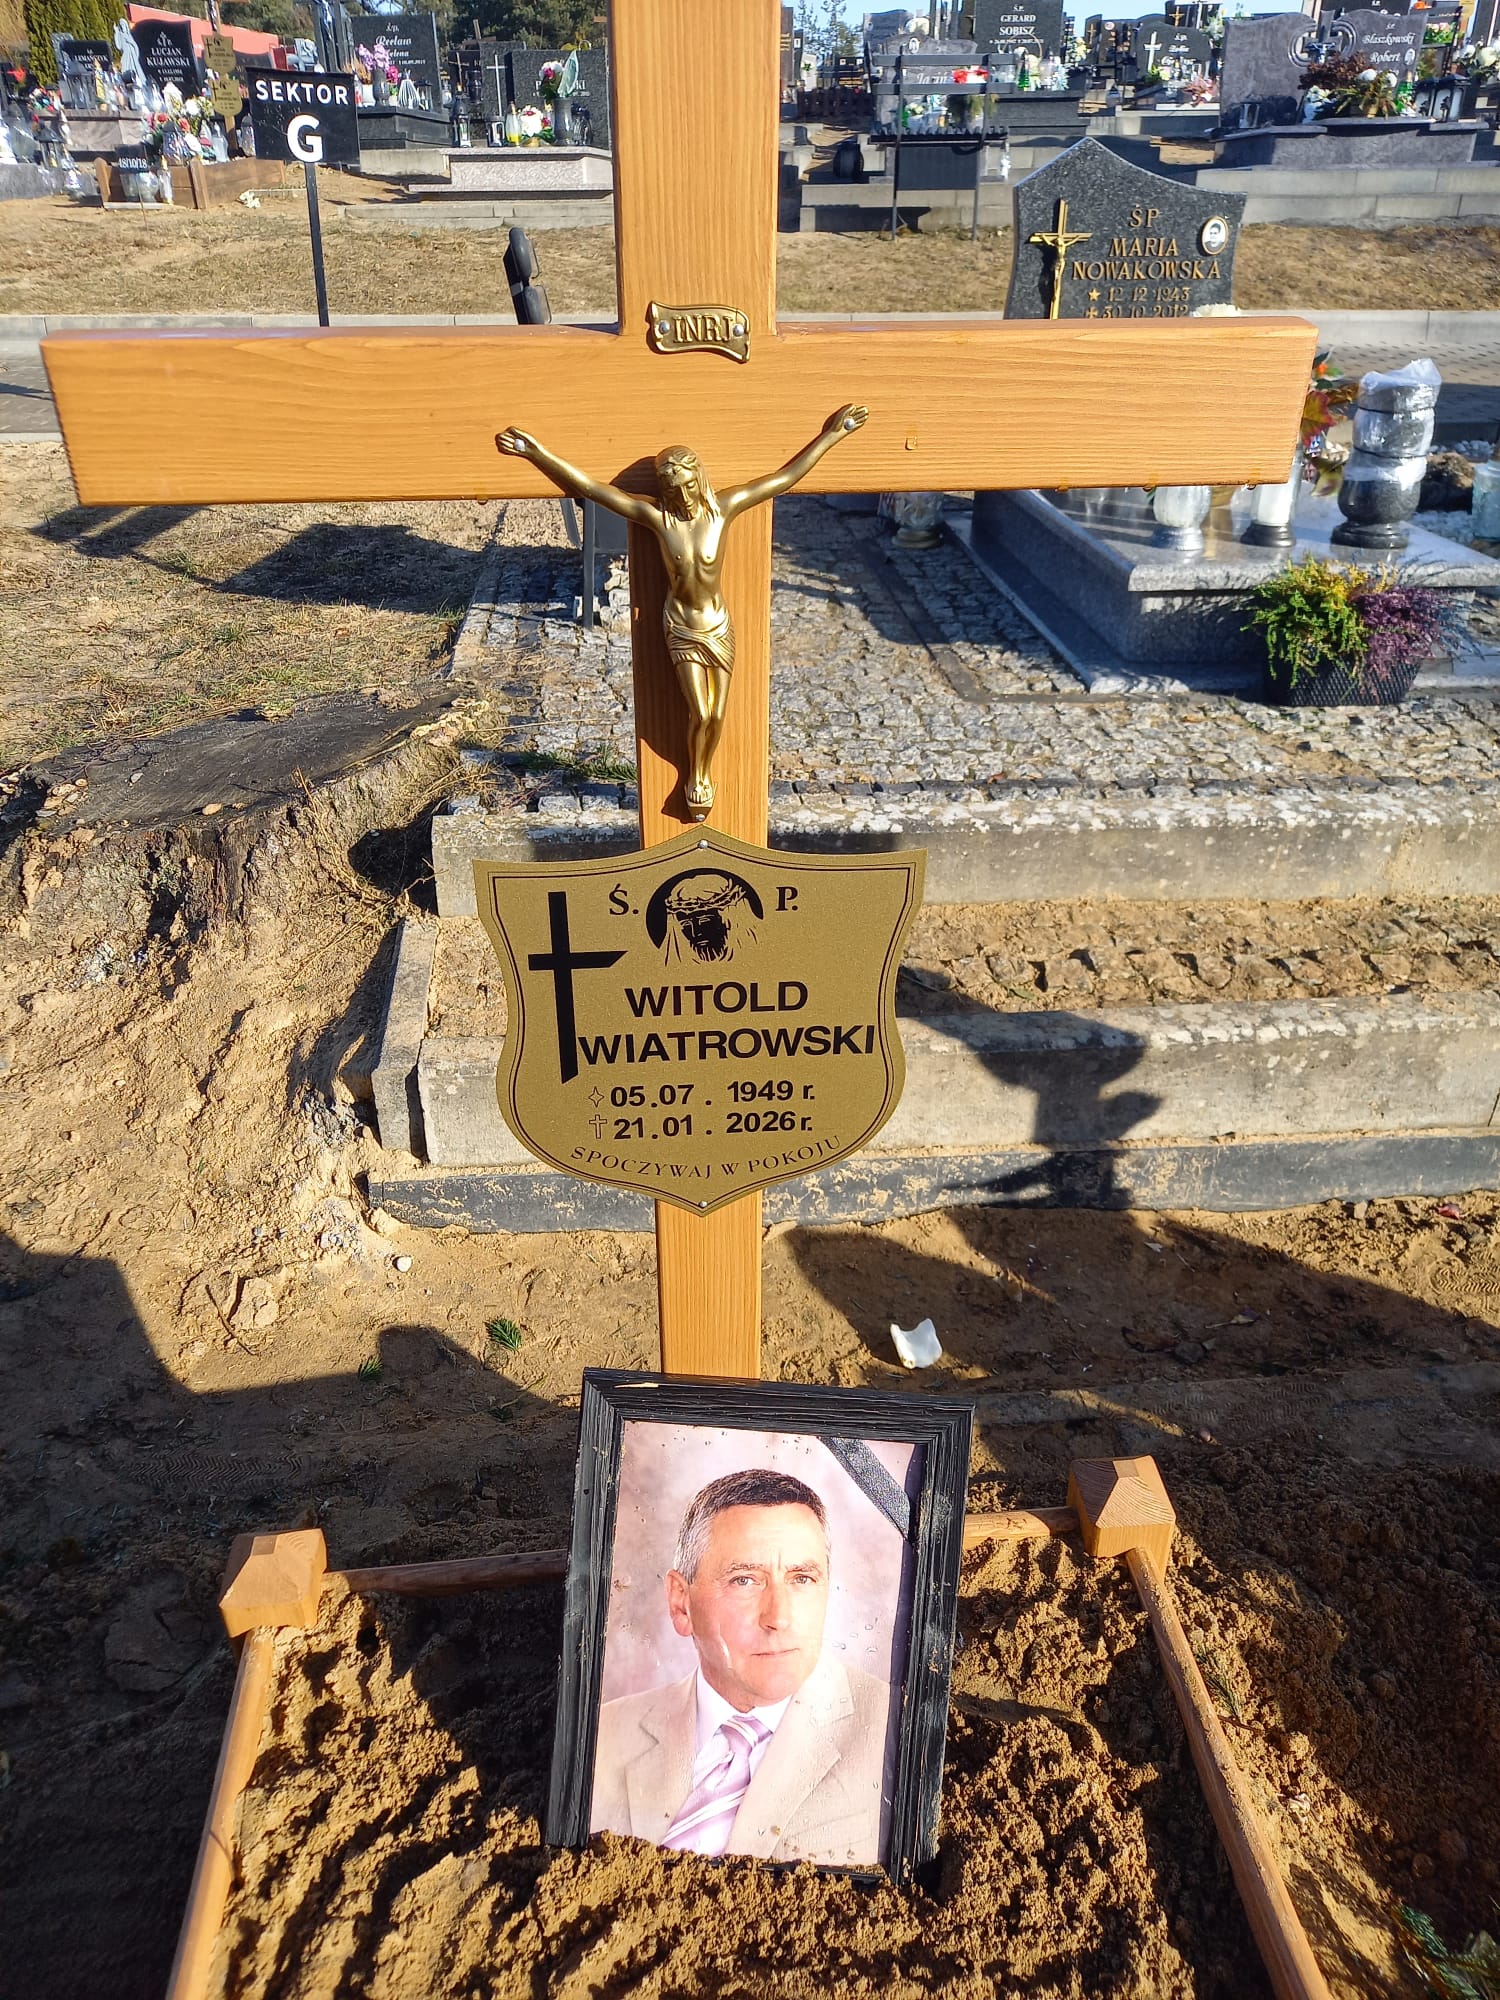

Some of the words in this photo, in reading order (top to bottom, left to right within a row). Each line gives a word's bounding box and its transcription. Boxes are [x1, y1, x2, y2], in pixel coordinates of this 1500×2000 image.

[1000, 14, 1036, 23] GERARD
[1000, 26, 1036, 36] SOBISZ
[146, 57, 190, 67] KUJAWSKI
[1370, 50, 1401, 64] Robert
[255, 79, 349, 106] SEKTOR
[286, 114, 324, 163] G
[1128, 203, 1161, 229] ŚP
[1108, 237, 1180, 257] MARIA
[1072, 259, 1221, 281] NOWAKOWSKA
[672, 313, 734, 343] INRI
[608, 883, 640, 916] Ś.
[775, 886, 799, 912] P.
[624, 981, 809, 1018] WITOLD
[578, 1024, 876, 1066] WIATROWSKI
[726, 1080, 794, 1103] 1949
[570, 1146, 712, 1180] SPOCZYWAJ
[720, 1162, 740, 1176] W
[747, 1135, 842, 1173] POKOJU
